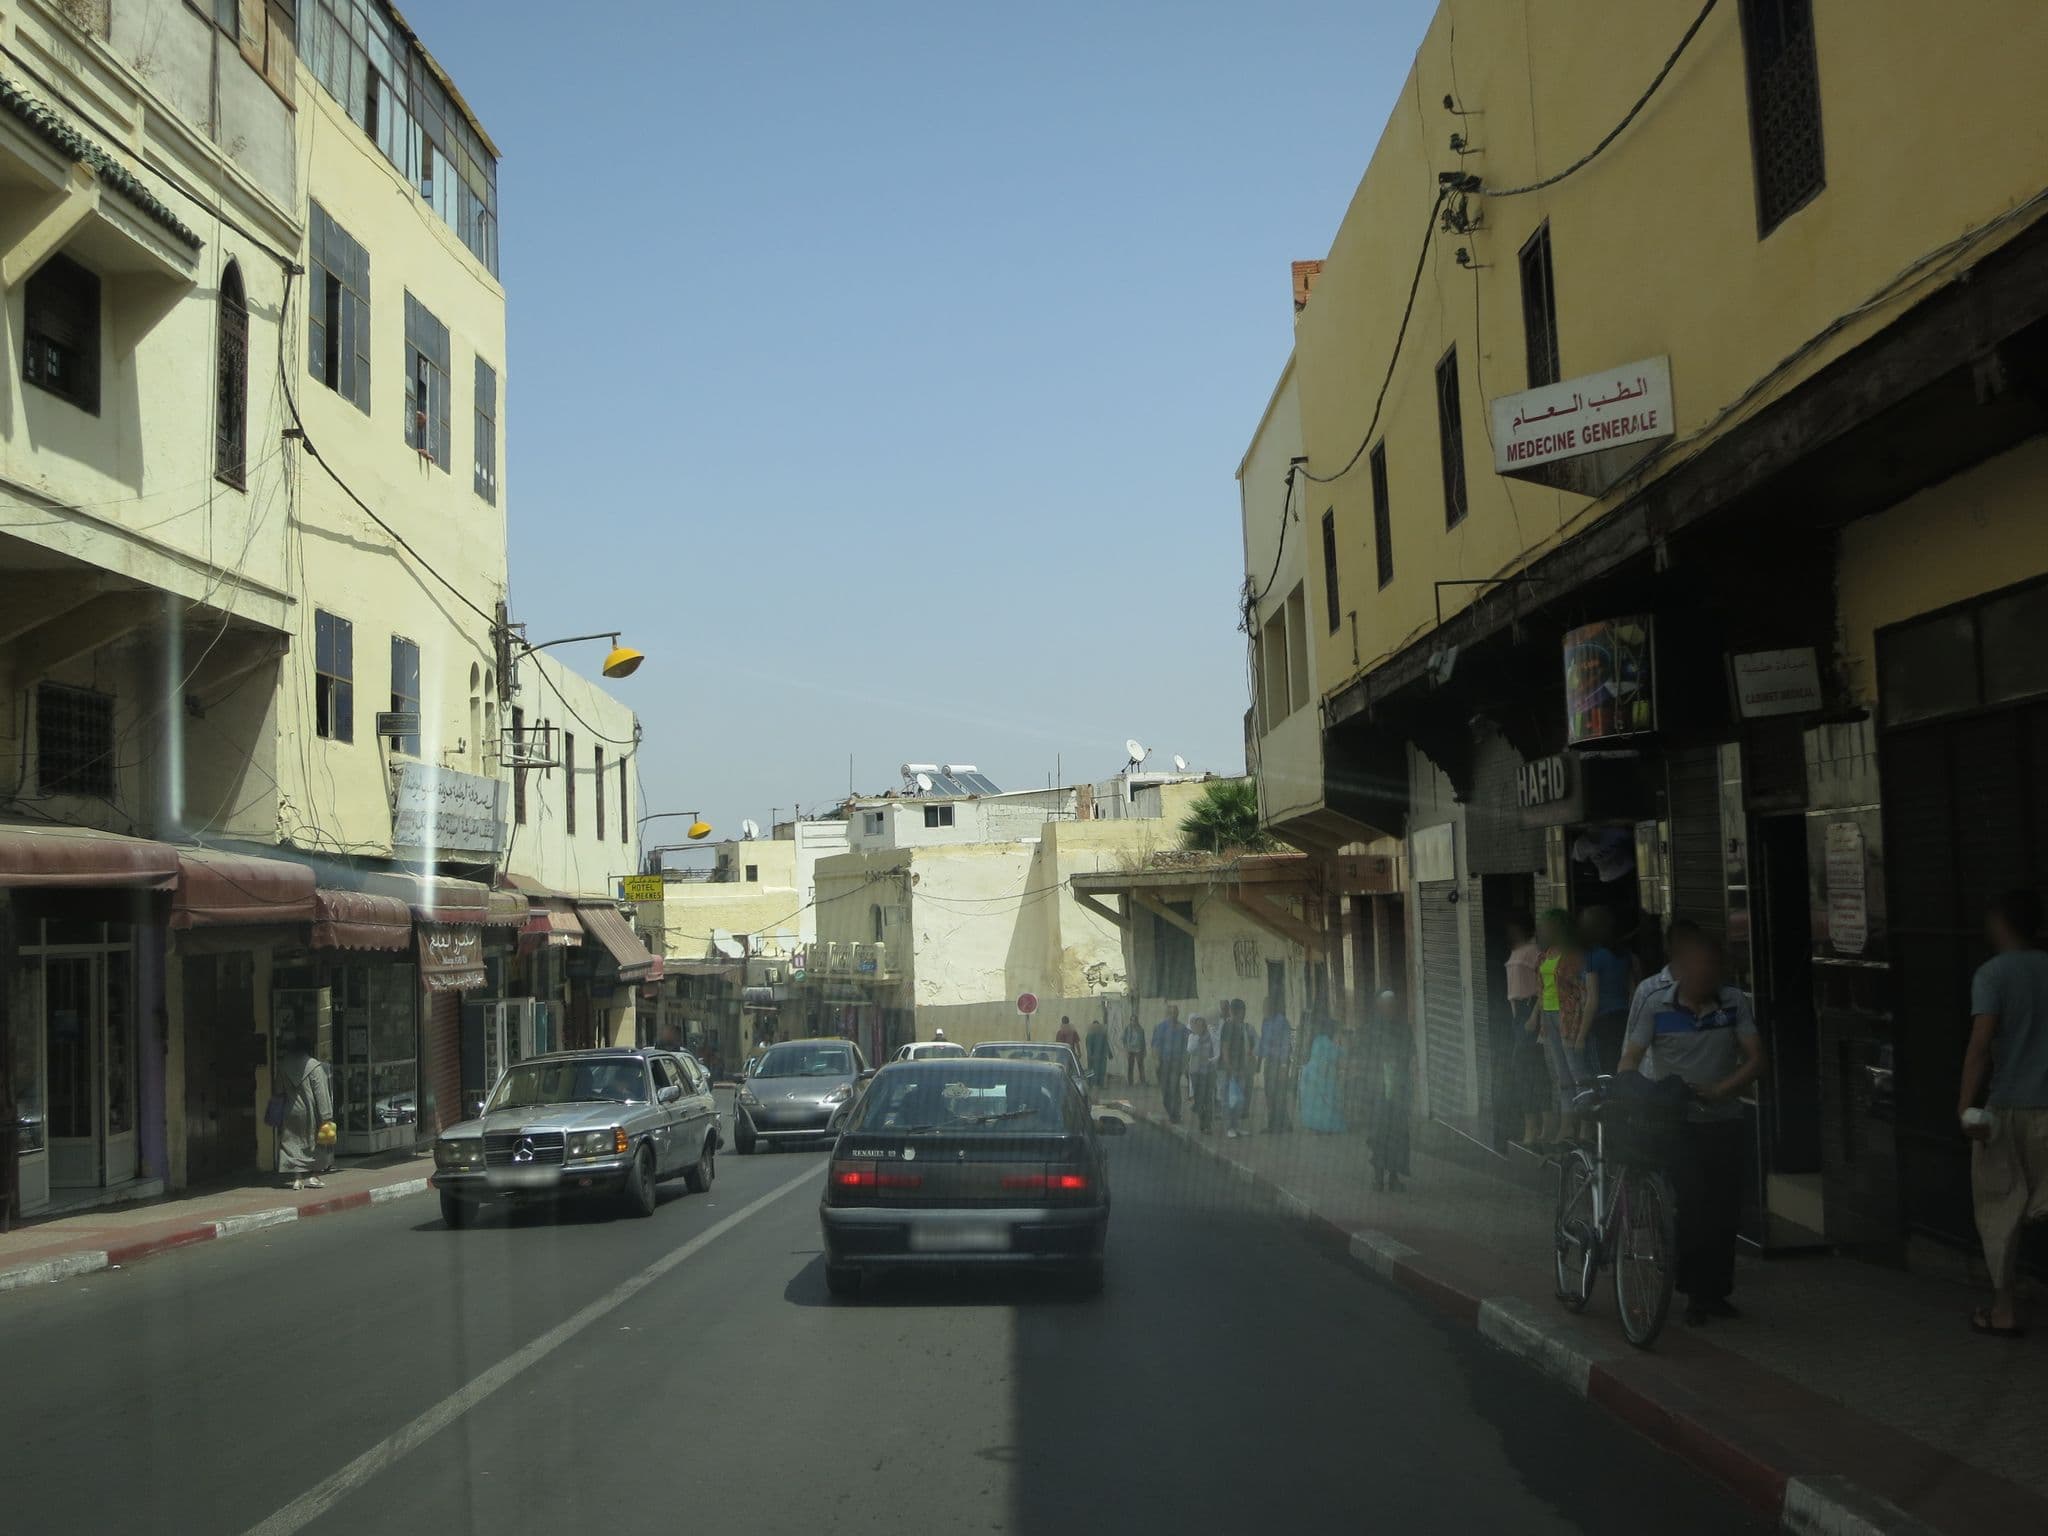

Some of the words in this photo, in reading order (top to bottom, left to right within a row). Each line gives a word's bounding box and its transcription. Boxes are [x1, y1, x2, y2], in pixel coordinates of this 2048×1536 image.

[1588, 376, 1648, 412] الطب
[1511, 393, 1582, 434] العام
[1507, 429, 1575, 462] MEDECINE
[1582, 410, 1657, 444] GENERALE
[1516, 756, 1565, 807] HAFID
[631, 883, 655, 891] HOTEL
[635, 891, 661, 900] MEKNES
